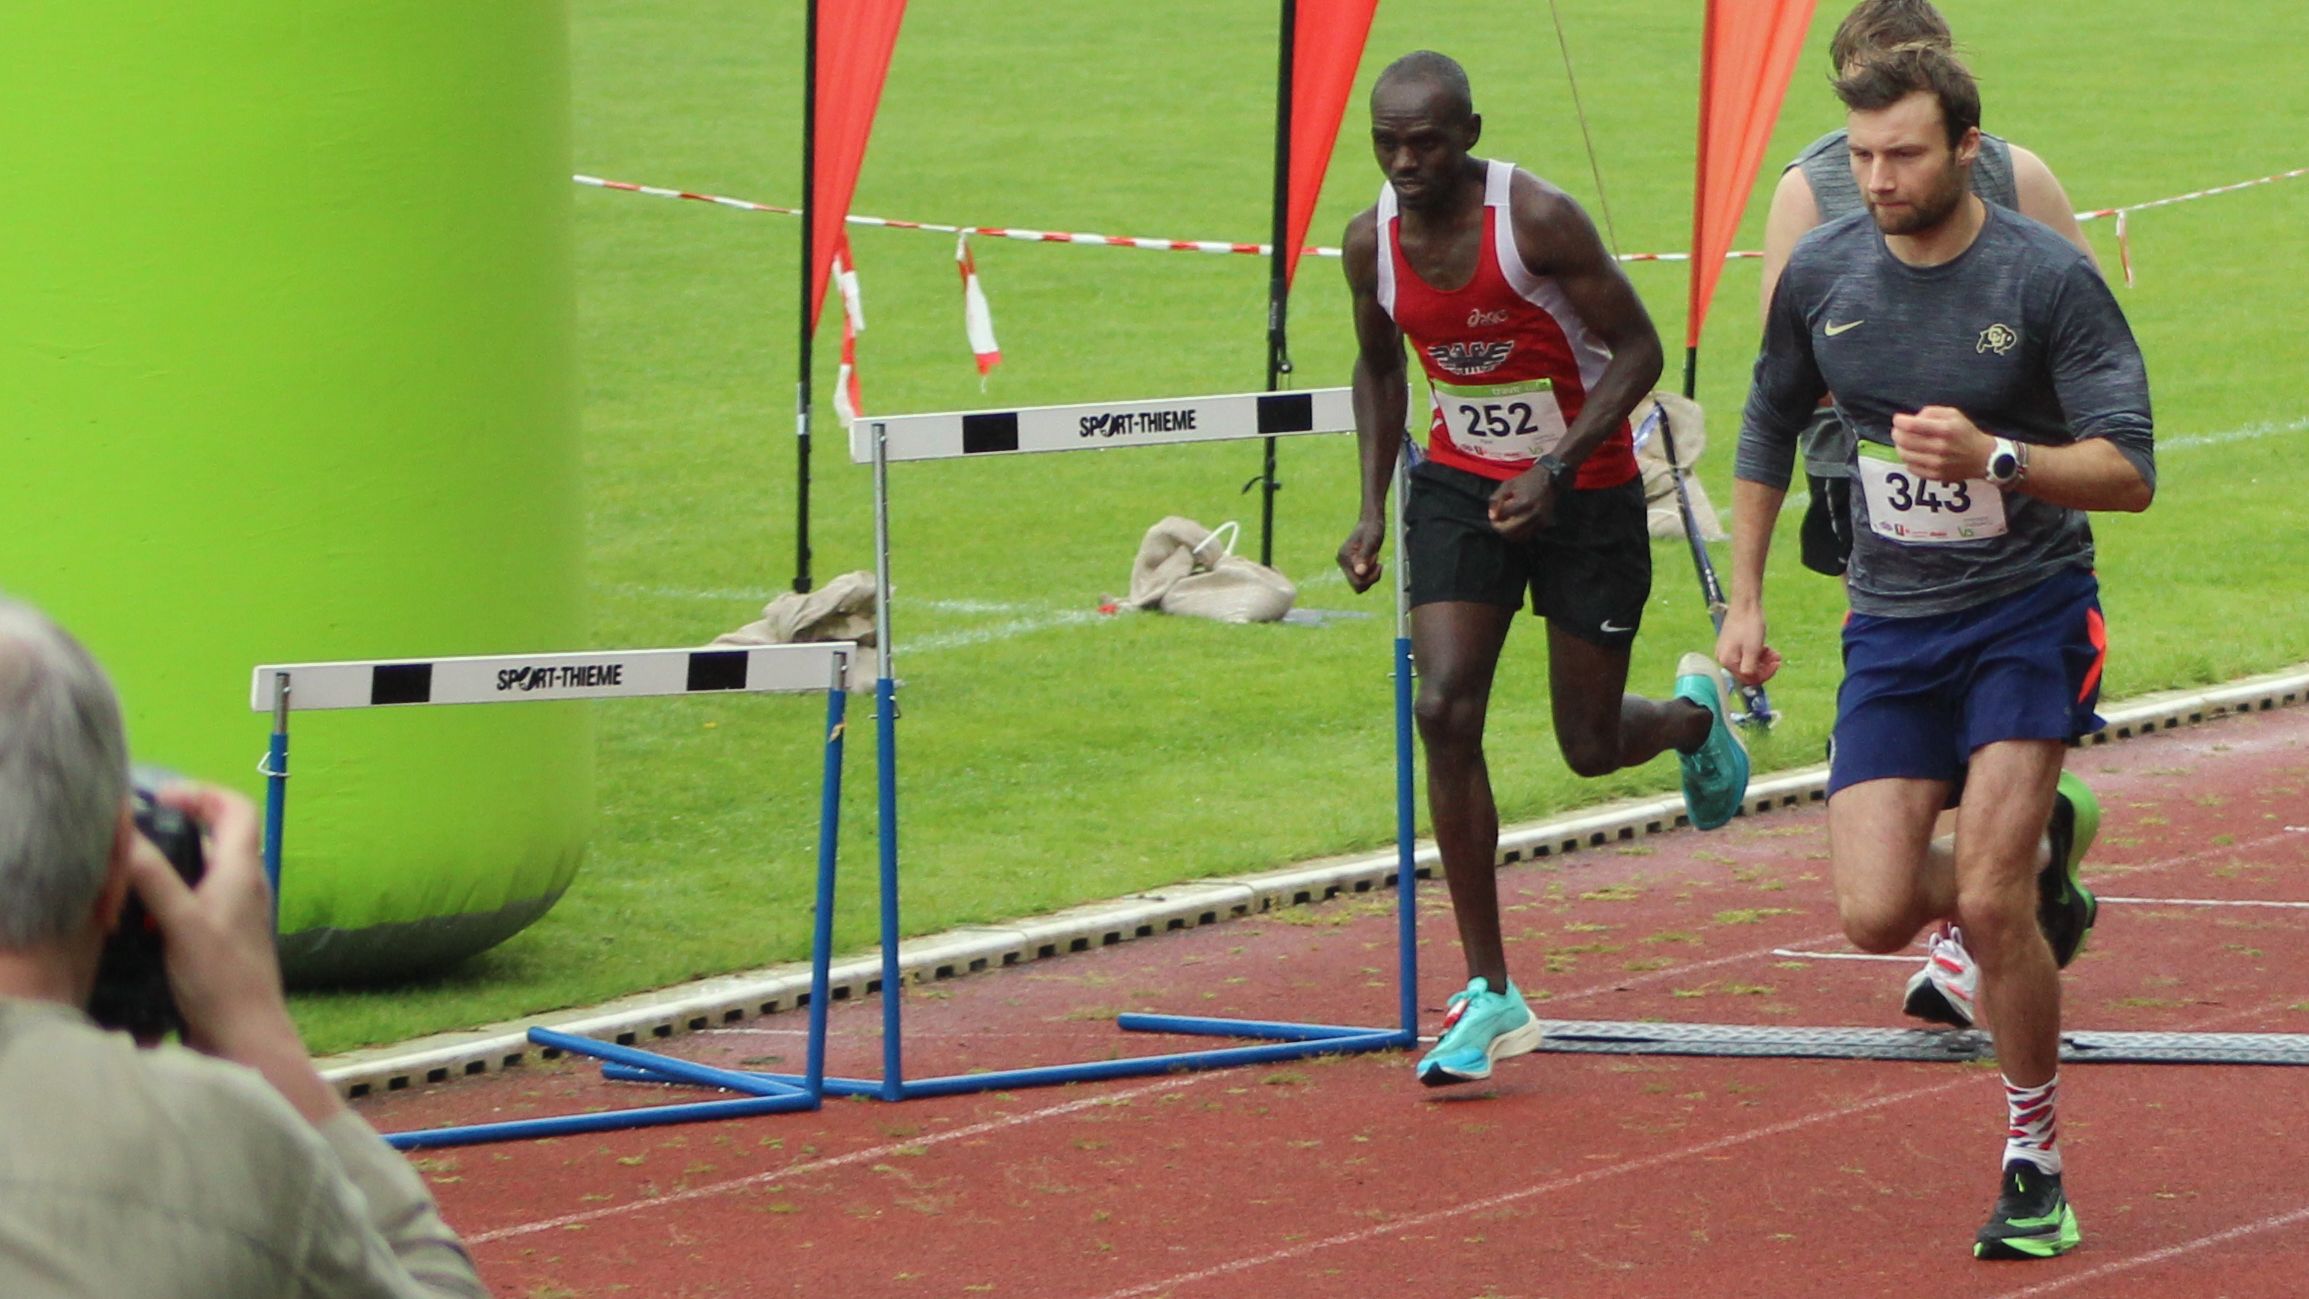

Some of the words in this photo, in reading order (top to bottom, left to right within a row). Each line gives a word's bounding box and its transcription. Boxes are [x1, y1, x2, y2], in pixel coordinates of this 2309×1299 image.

[1080, 409, 1196, 437] SPORT-THIEME
[1459, 402, 1538, 437] 252
[1886, 472, 1971, 513] 343
[497, 664, 623, 691] SPORT-THIEME
